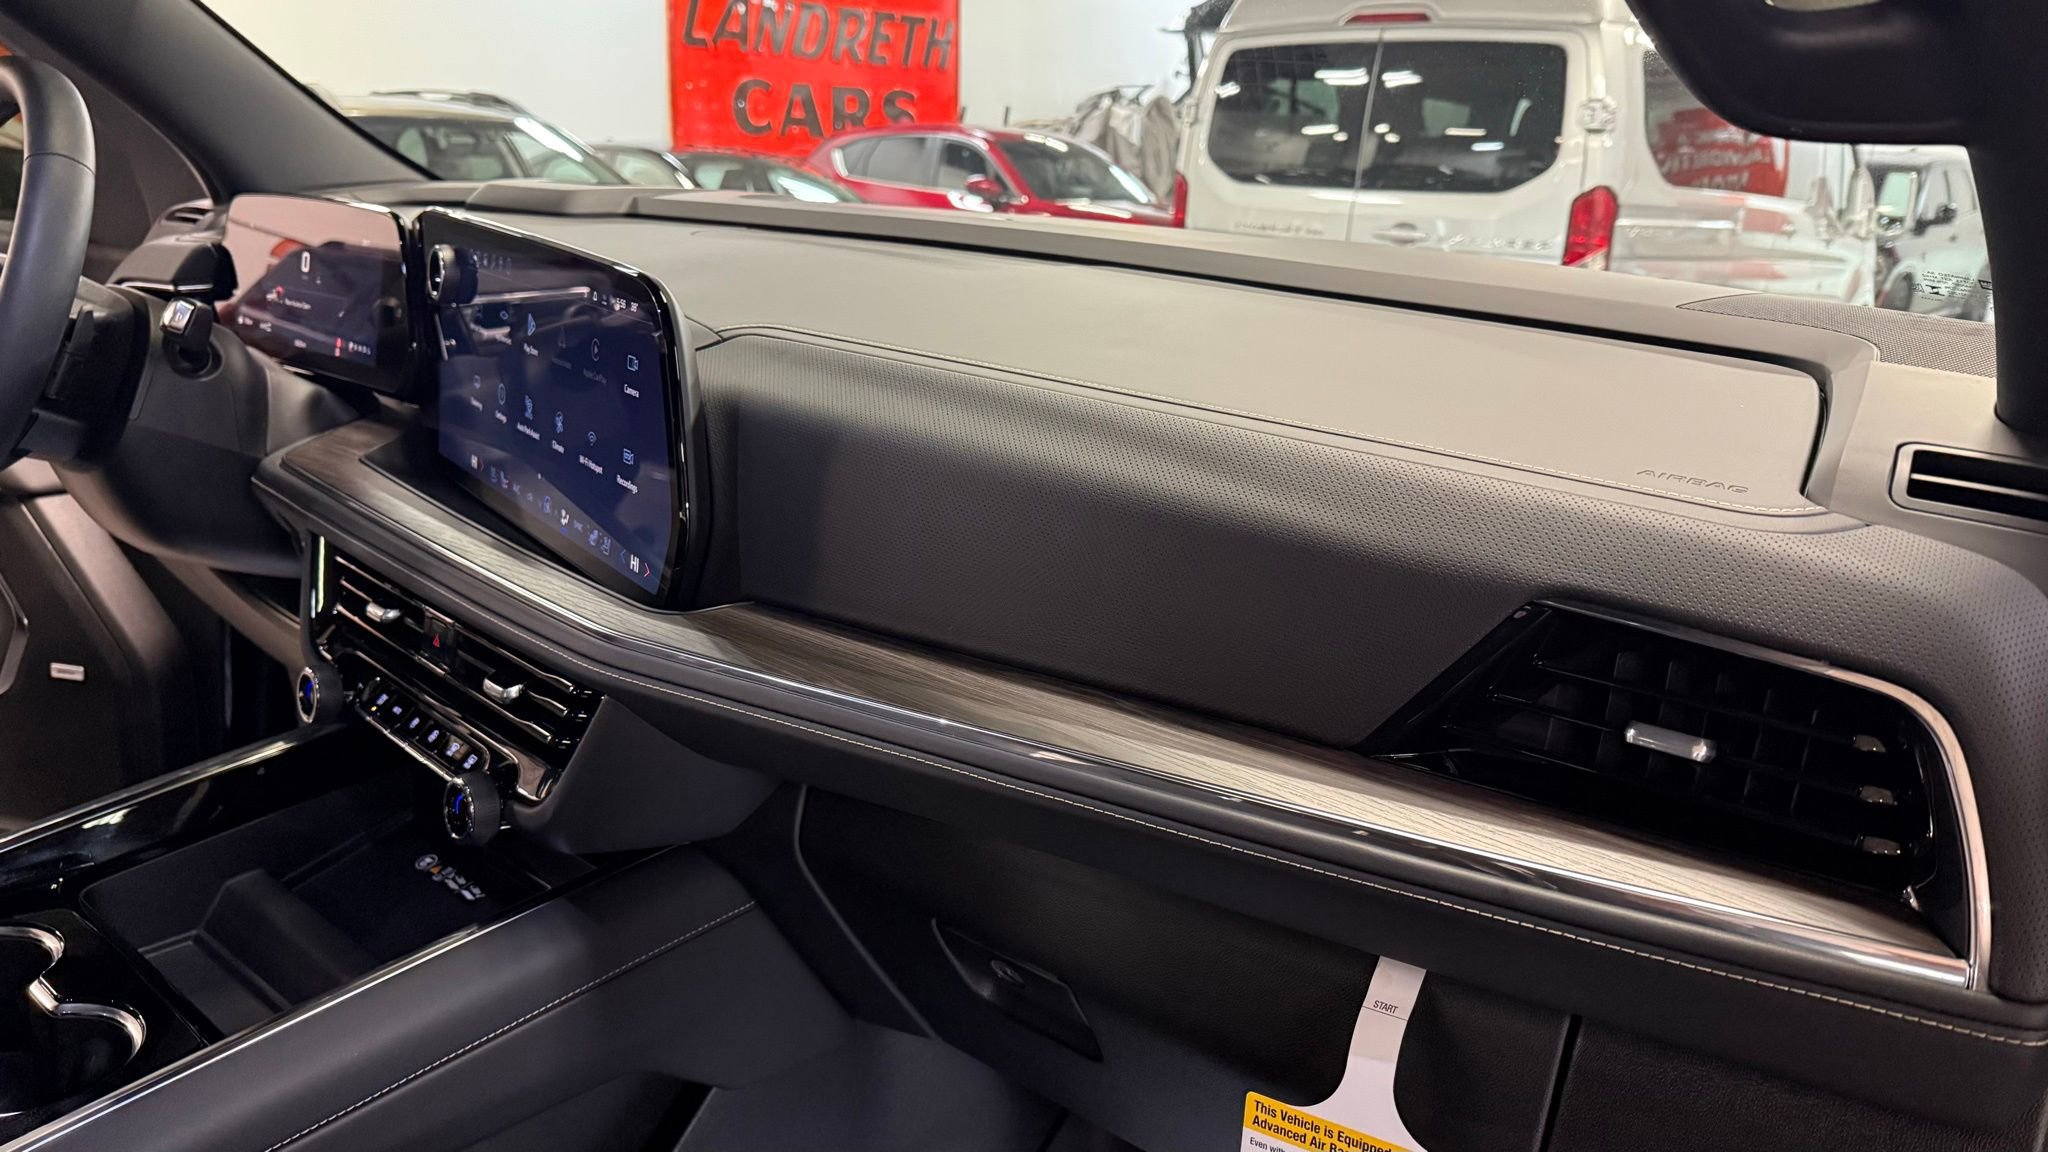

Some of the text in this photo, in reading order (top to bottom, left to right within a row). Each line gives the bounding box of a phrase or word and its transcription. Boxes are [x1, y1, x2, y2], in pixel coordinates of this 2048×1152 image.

[682, 0, 954, 71] LANDRETH
[733, 78, 918, 138] CARS
[301, 251, 311, 273] 0
[624, 383, 640, 398] Camera
[616, 474, 638, 494] Recordings
[1636, 468, 1749, 495] AIRBAG
[630, 553, 640, 574] HI
[1372, 1000, 1399, 1015] START
[1254, 1099, 1277, 1118] This
[1280, 1108, 1321, 1134] Vehicle
[1324, 1124, 1334, 1139] is
[1249, 1136, 1268, 1151] Even
[1252, 1115, 1307, 1144] Advanced
[1310, 1135, 1327, 1152] Air
